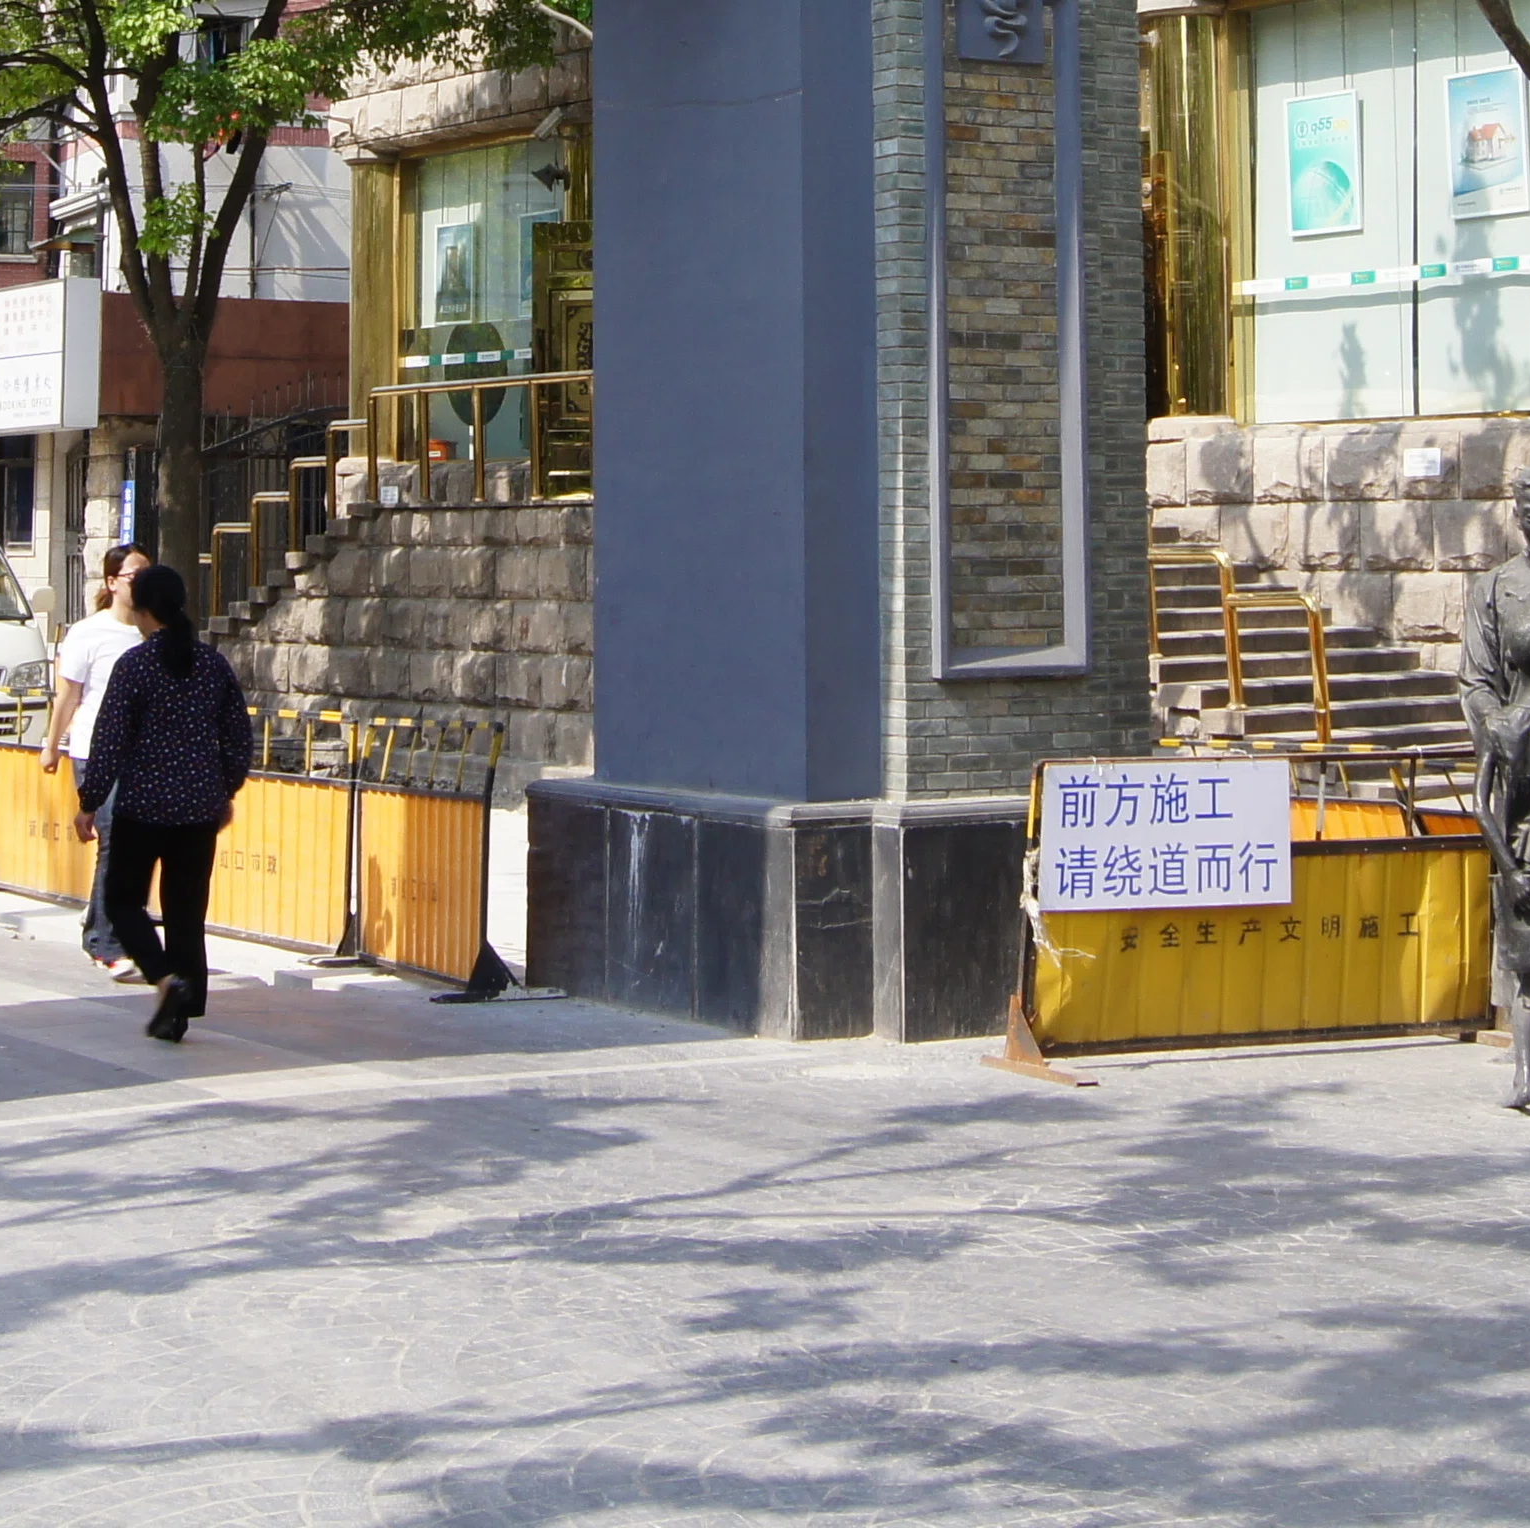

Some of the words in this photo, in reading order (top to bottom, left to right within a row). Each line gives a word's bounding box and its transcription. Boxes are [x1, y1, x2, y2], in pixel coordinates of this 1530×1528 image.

[1058, 773, 1235, 829] 前方施工
[1055, 840, 1279, 899] 请绕道而行
[1121, 912, 1420, 953] 安全生产文明施工
